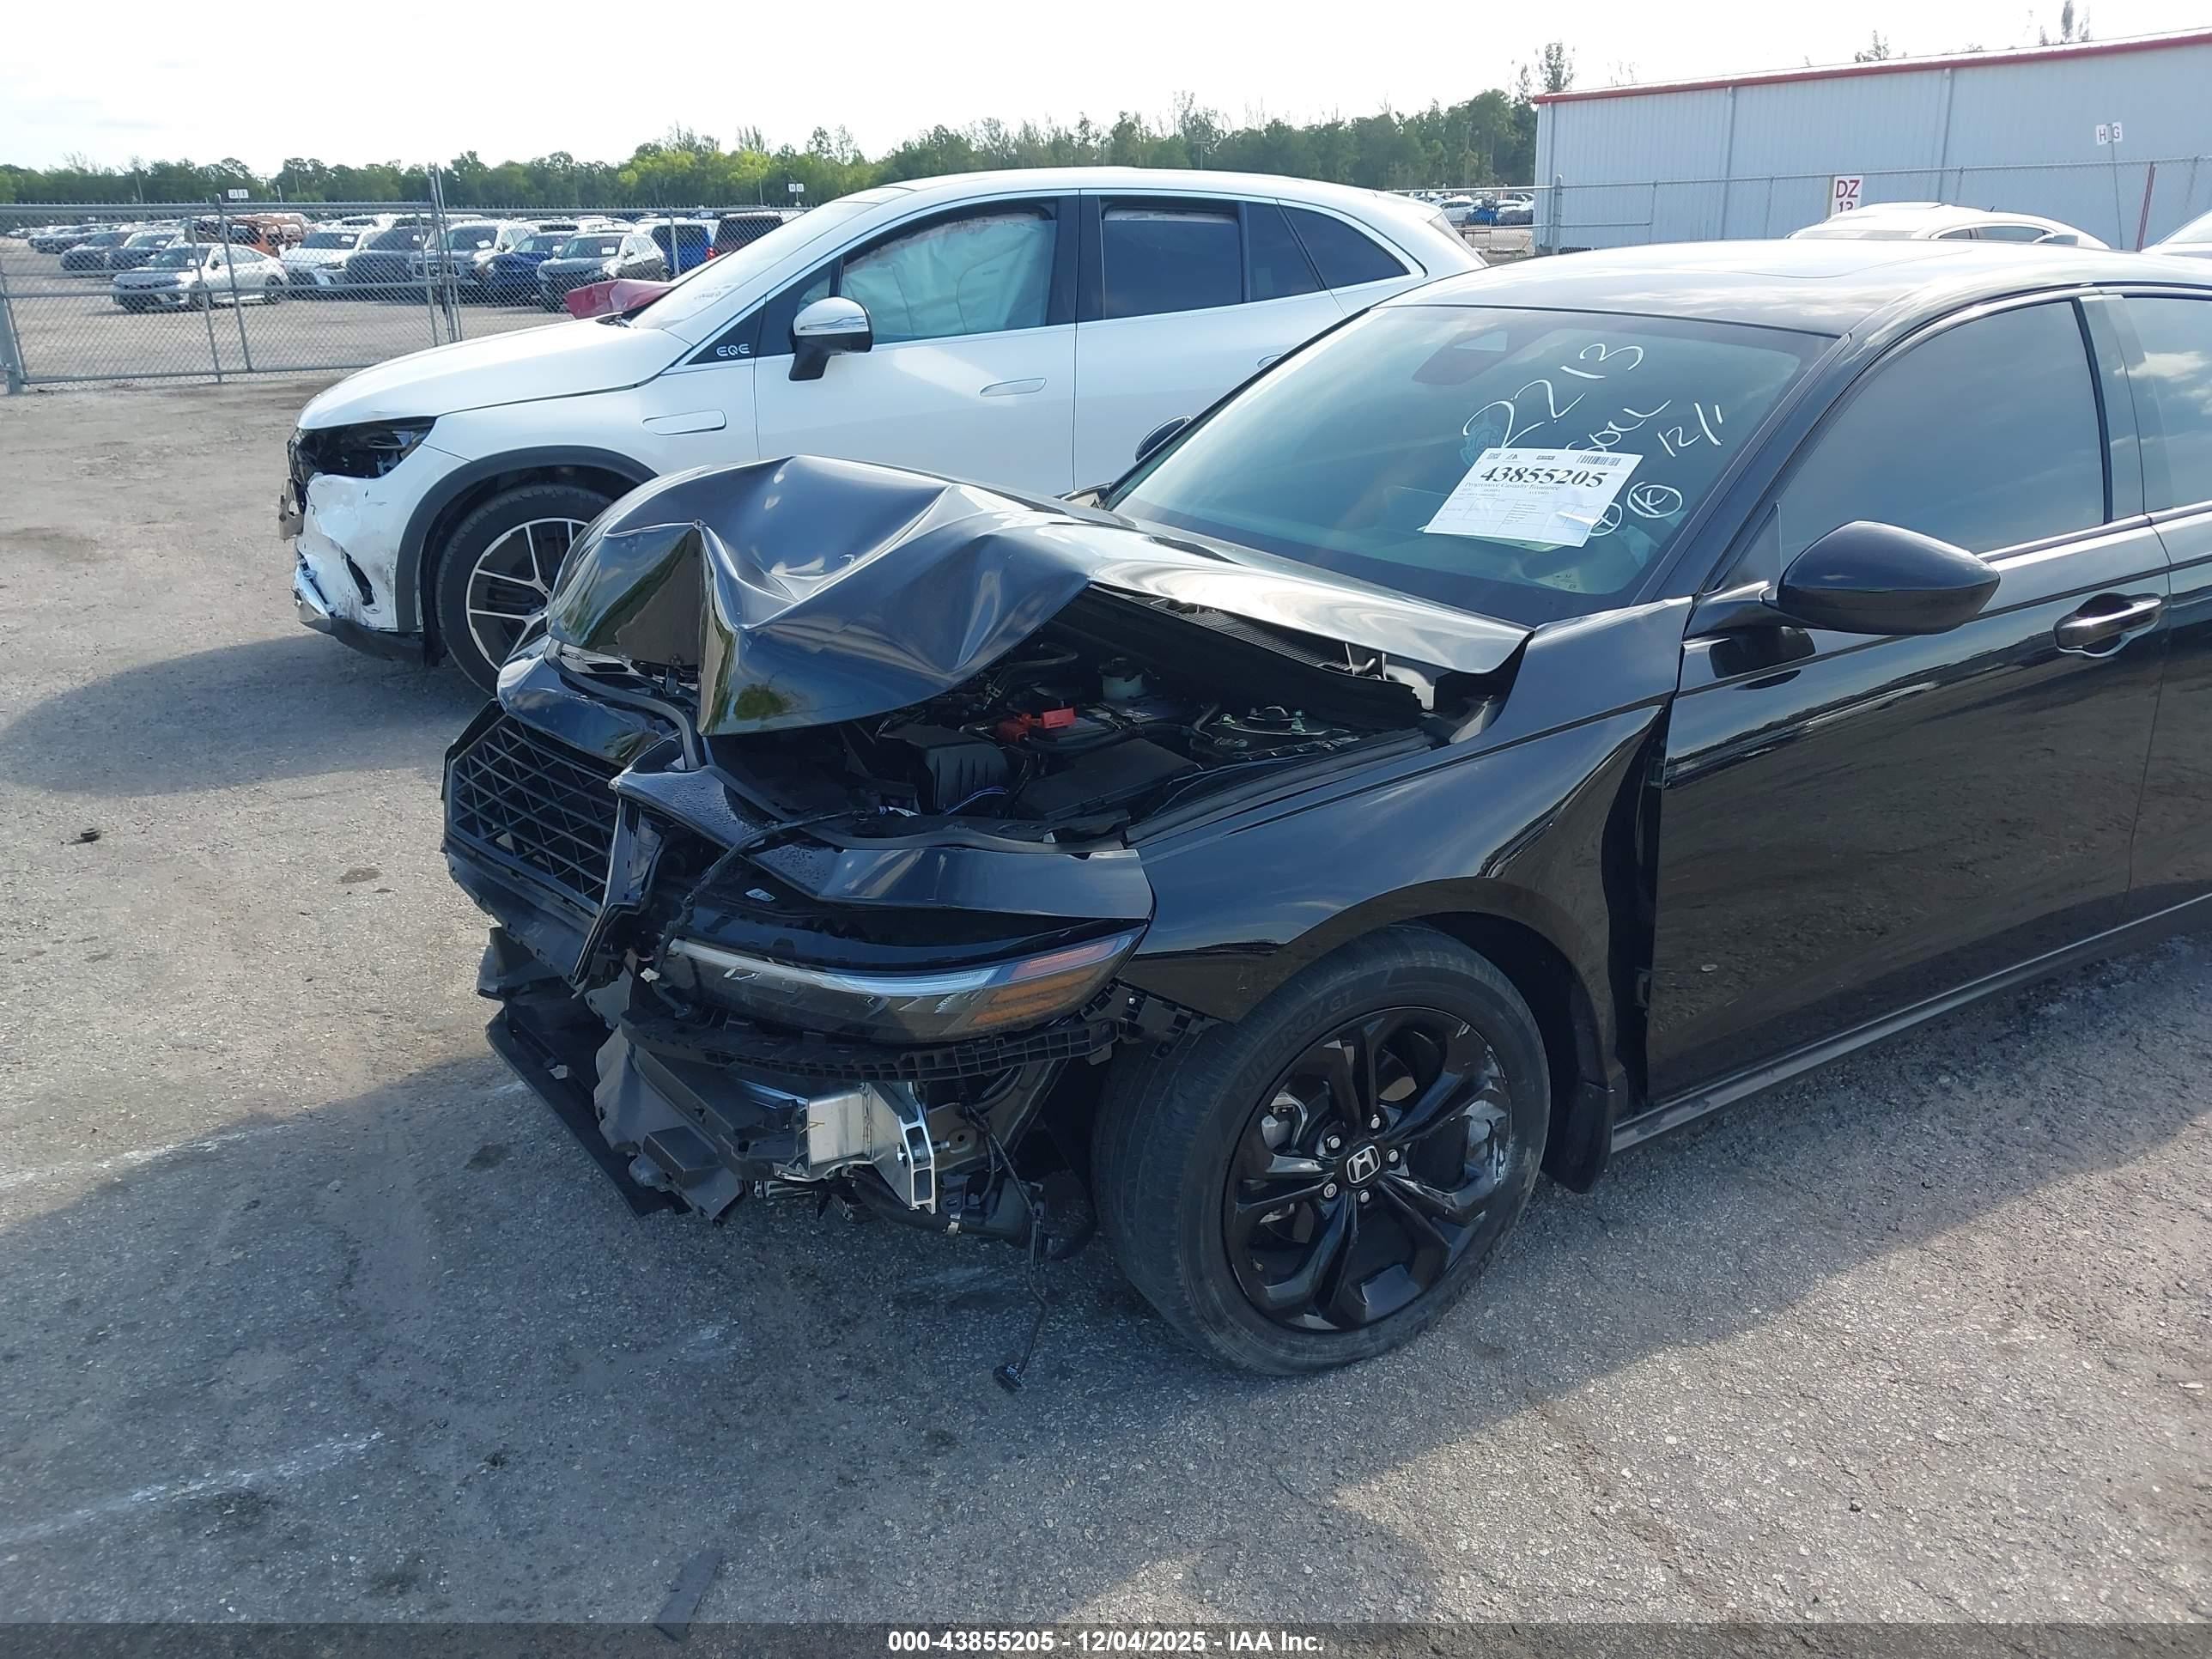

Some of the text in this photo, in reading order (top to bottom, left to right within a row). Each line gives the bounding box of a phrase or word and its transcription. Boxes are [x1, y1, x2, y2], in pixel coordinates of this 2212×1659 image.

[2099, 128, 2106, 142] H
[2113, 125, 2120, 139] G
[1836, 179, 1860, 198] DZ
[716, 343, 750, 357] EQE
[1462, 343, 1644, 448] 2213
[1480, 465, 1609, 488] 43855205
